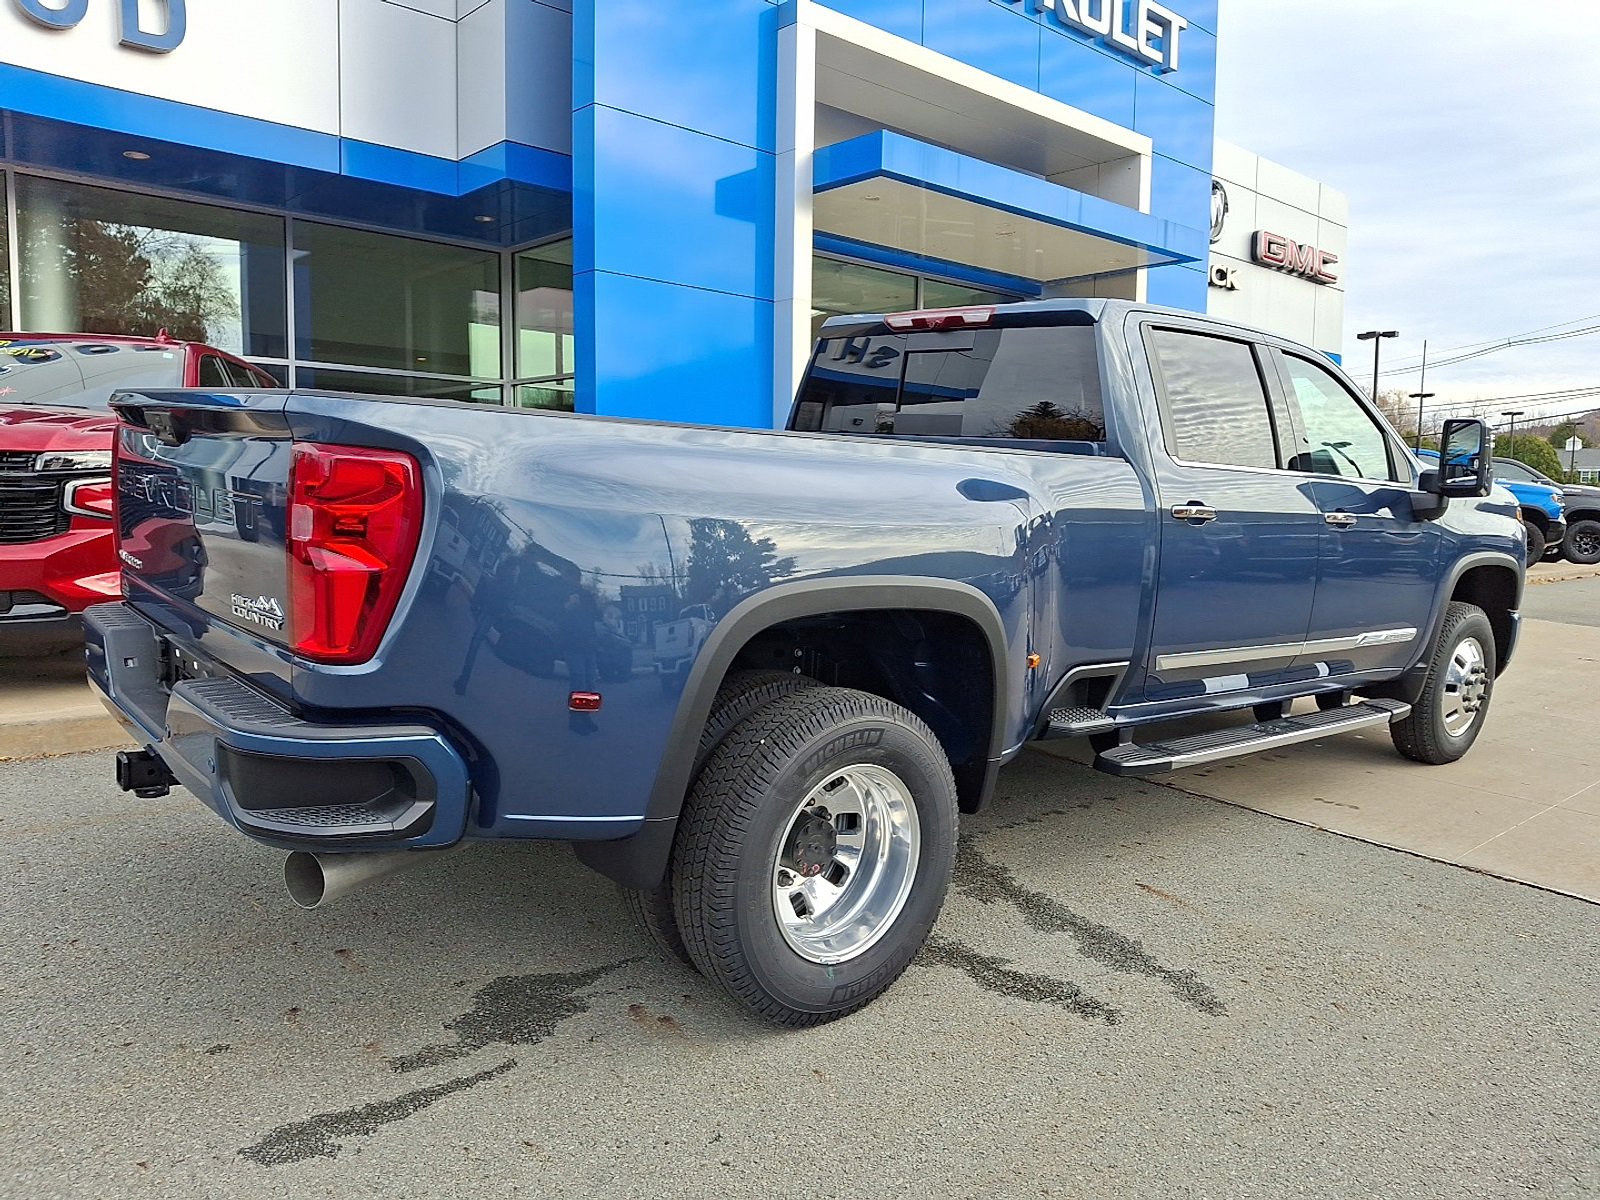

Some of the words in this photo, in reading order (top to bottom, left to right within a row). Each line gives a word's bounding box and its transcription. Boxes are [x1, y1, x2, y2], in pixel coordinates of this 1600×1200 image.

[1252, 229, 1339, 285] GMC
[231, 593, 256, 610] HIGH
[231, 605, 283, 631] COUNTRY
[802, 729, 883, 777] MICHELIN
